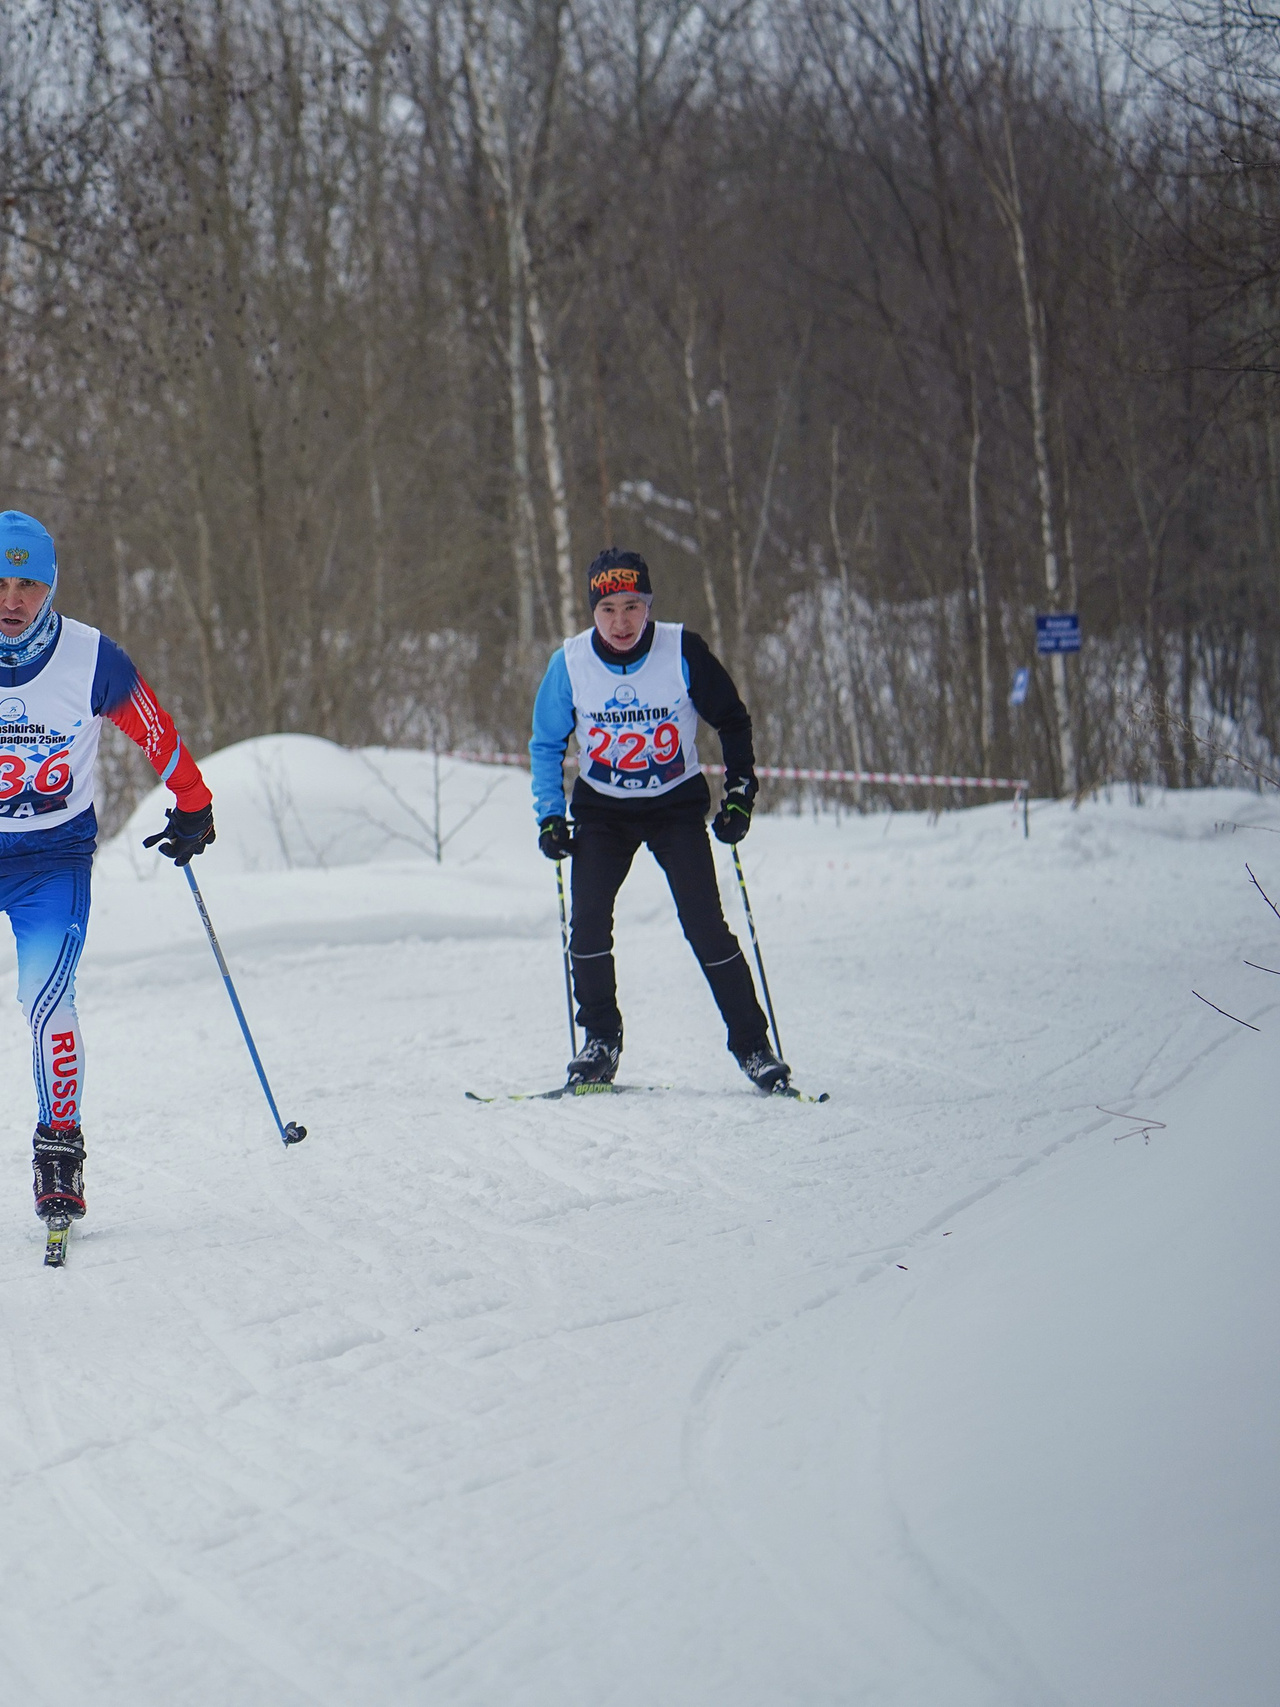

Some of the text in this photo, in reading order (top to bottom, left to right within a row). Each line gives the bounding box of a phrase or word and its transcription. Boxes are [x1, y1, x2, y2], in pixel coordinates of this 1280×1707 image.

[590, 568, 640, 591] KARST
[588, 722, 680, 770] 229
[609, 770, 663, 789] УФА
